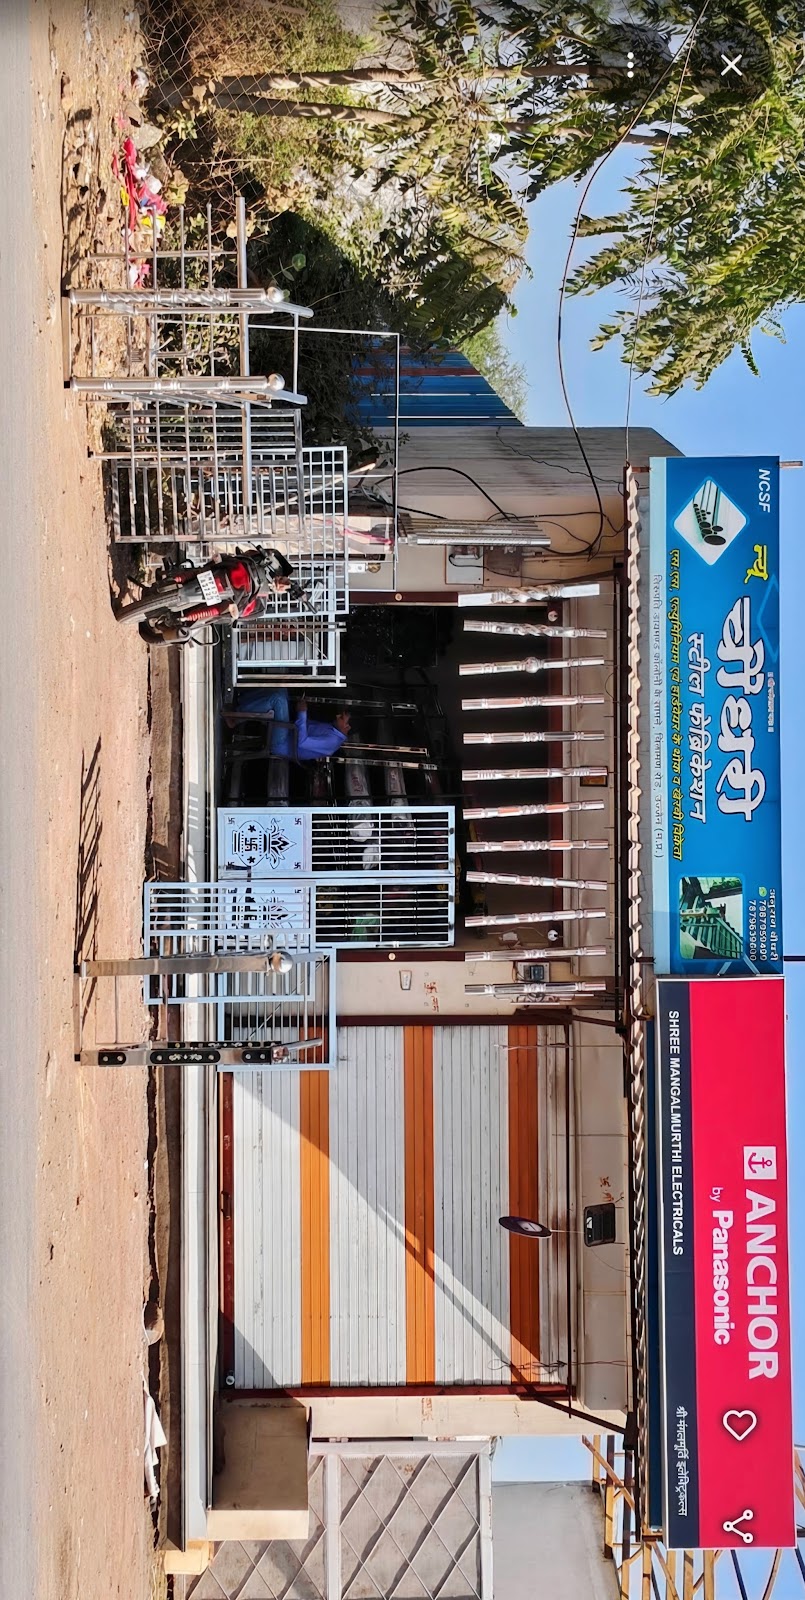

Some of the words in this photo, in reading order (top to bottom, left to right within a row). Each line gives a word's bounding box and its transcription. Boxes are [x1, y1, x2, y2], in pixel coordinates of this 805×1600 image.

[758, 469, 770, 513] NCSF
[744, 544, 768, 584] न्यू
[687, 632, 711, 697] स्टील
[654, 689, 663, 698] के
[716, 596, 766, 821] चौधरी
[671, 733, 683, 745] के
[671, 776, 681, 787] व
[688, 702, 713, 824] फेब्रिकेशन
[767, 888, 777, 928] अनुराग
[668, 1010, 680, 1054] SHREE
[669, 1057, 682, 1163] MANGALMURTHI
[671, 1166, 683, 1256] ELECTRICALS
[709, 1187, 723, 1202] by
[712, 1210, 735, 1345] Panasonic
[745, 1189, 779, 1379] ANCHOR
[676, 1406, 688, 1418] श्री
